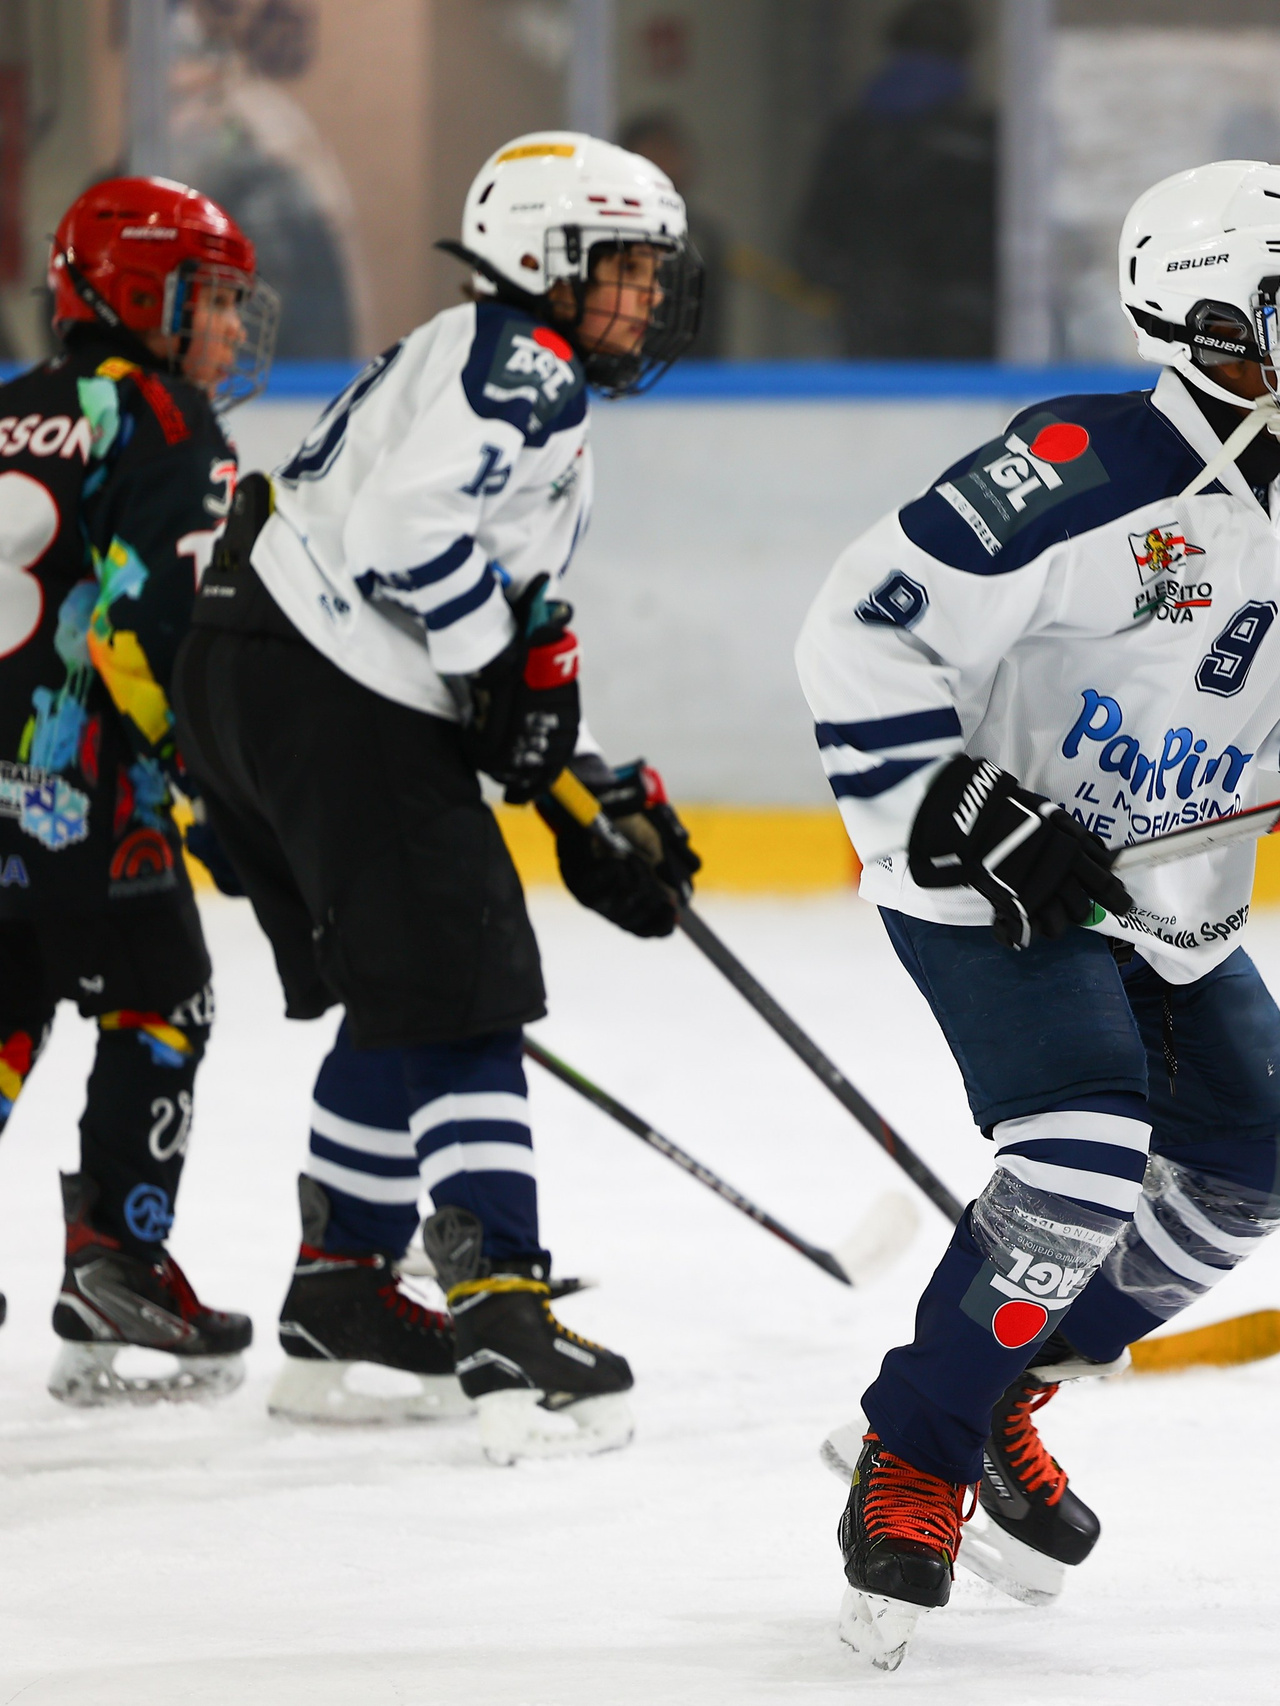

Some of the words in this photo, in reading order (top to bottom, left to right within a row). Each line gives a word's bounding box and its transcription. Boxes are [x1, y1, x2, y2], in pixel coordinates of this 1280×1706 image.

[1166, 253, 1230, 272] BAUER
[1193, 334, 1246, 354] BAUER
[1195, 599, 1278, 698] 9
[1130, 906, 1177, 925] azione
